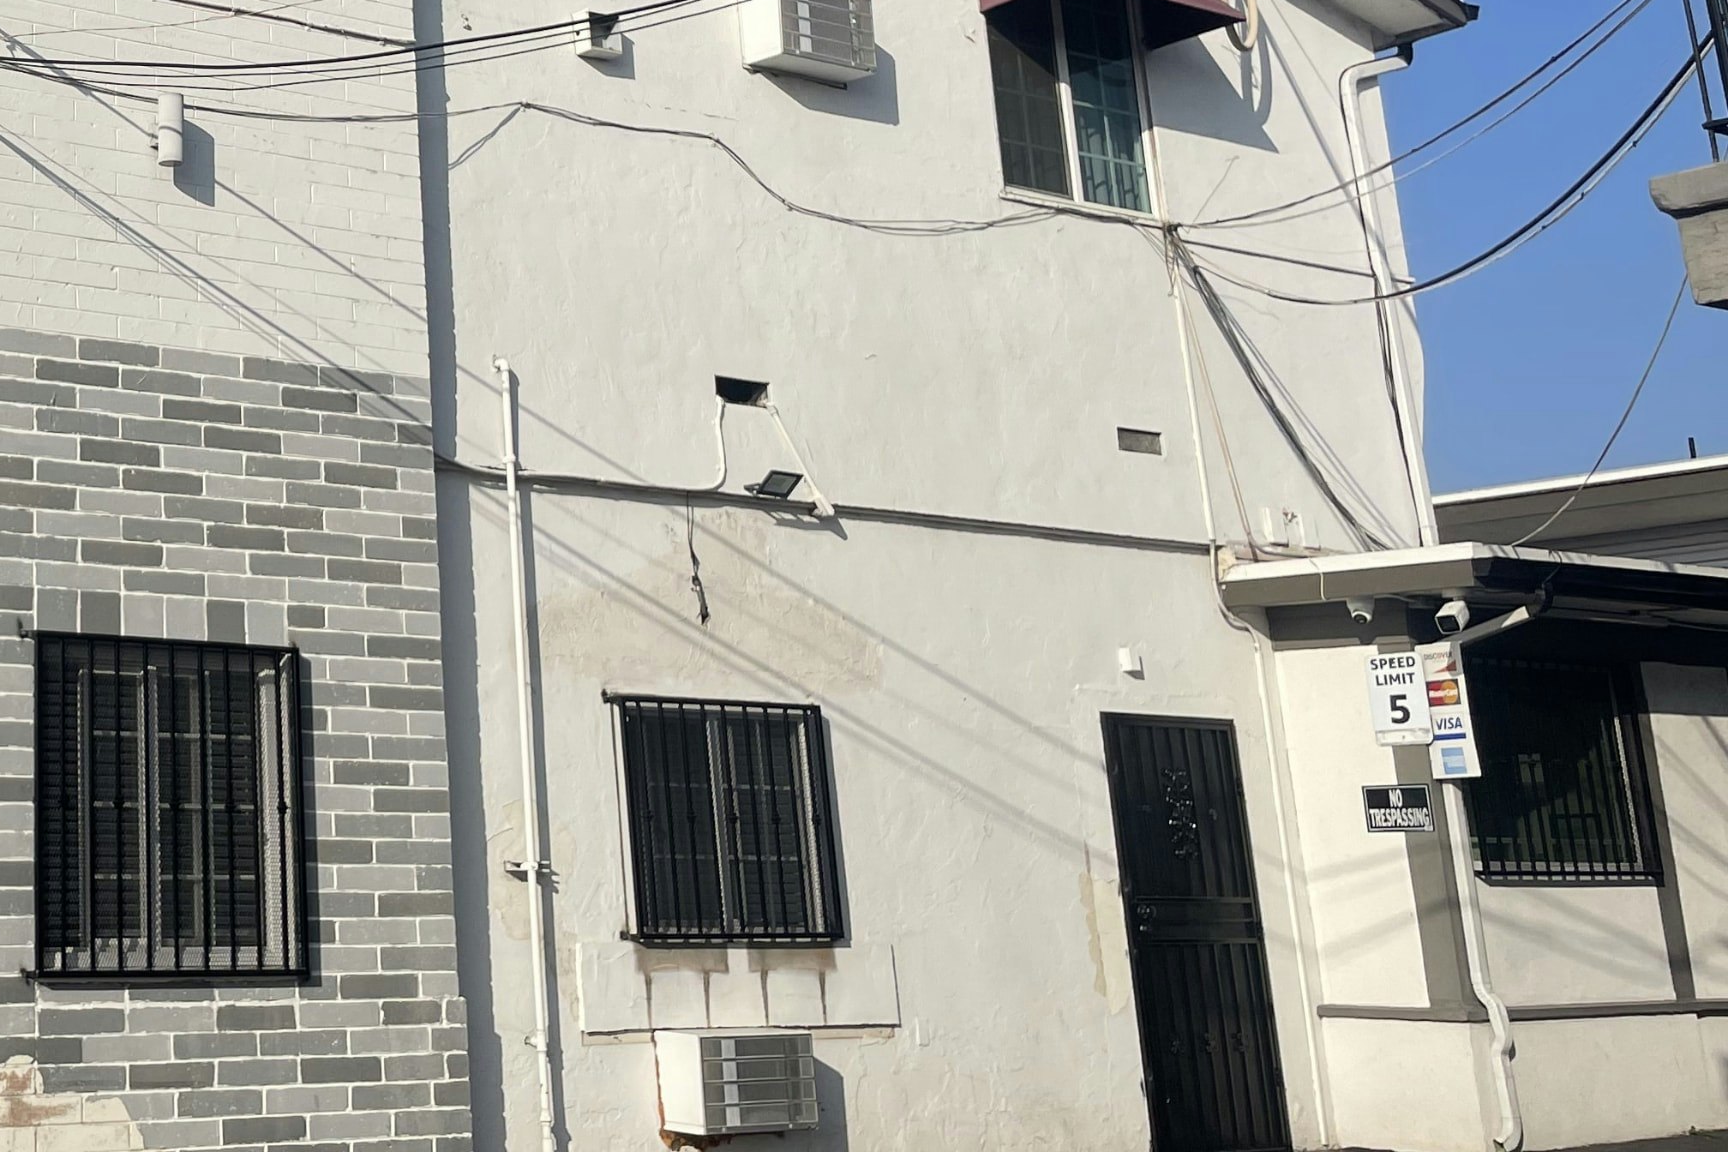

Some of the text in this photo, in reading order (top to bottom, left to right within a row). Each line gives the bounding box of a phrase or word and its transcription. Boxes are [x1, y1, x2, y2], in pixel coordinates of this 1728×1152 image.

[1369, 656, 1416, 671] SPEED
[1375, 672, 1415, 686] LIMIT
[1389, 694, 1411, 724] 5
[1435, 717, 1463, 730] VISA
[1388, 788, 1403, 808] NO
[1369, 807, 1430, 828] TRESPASSING
